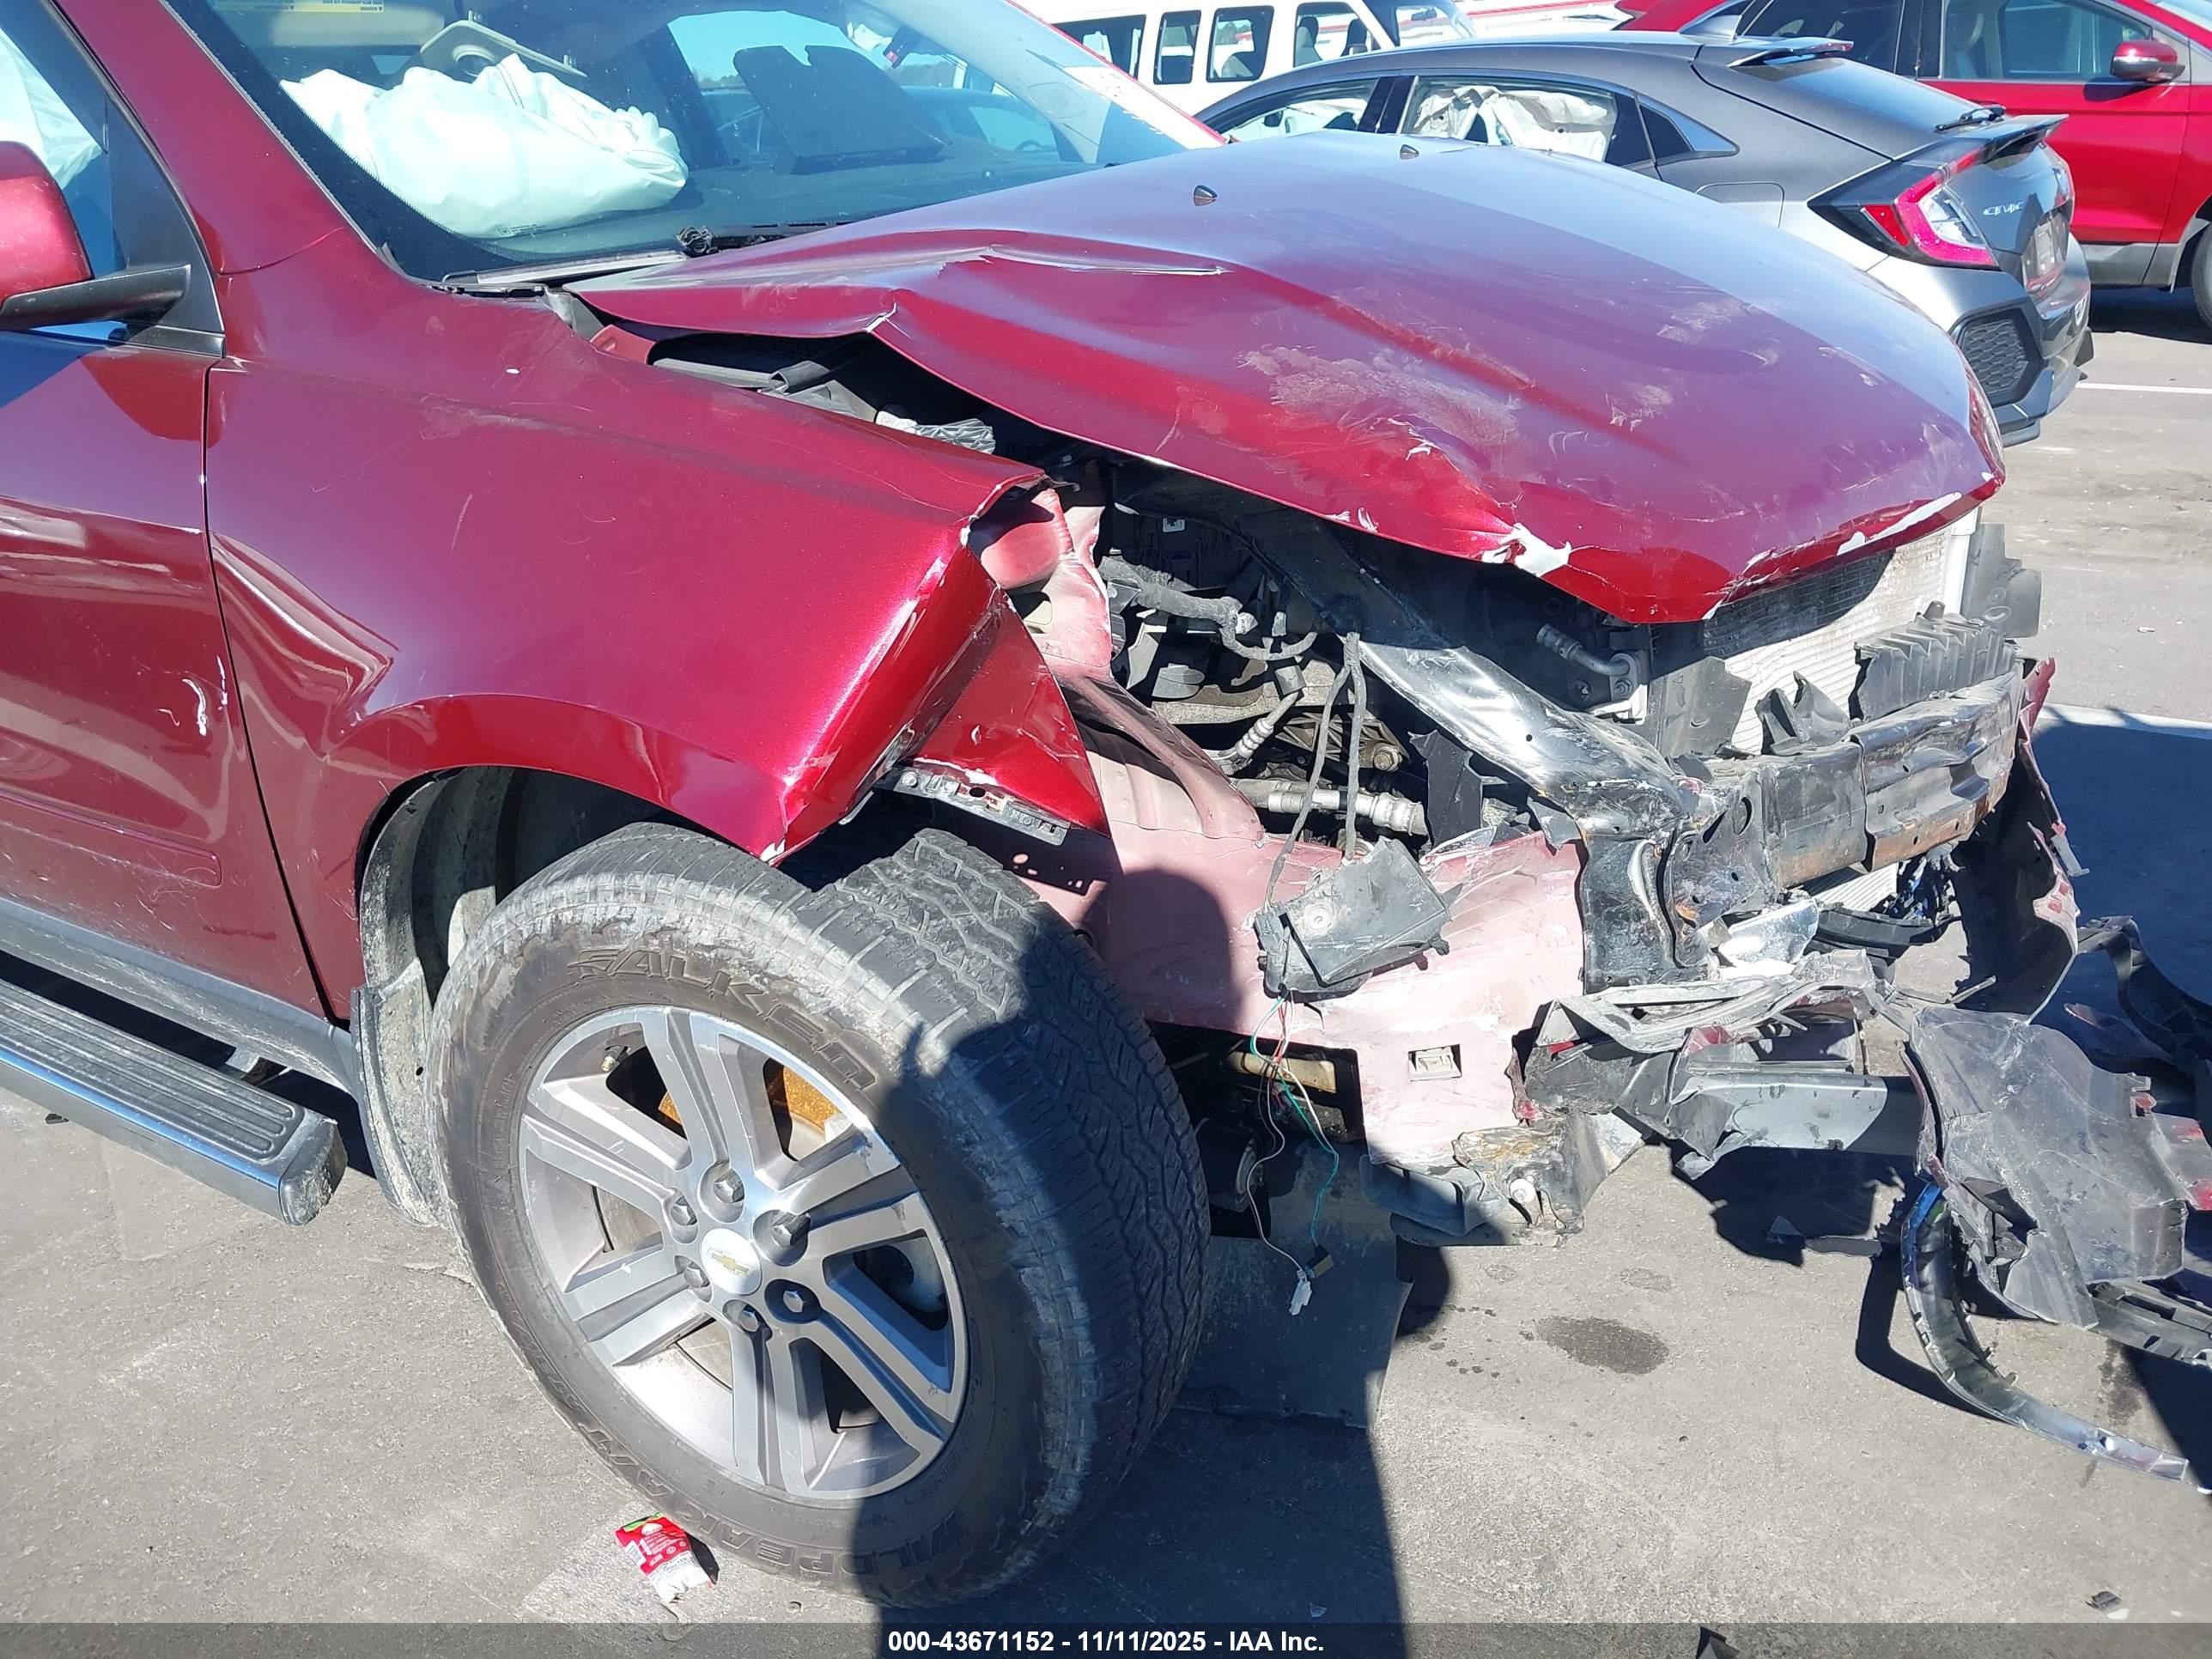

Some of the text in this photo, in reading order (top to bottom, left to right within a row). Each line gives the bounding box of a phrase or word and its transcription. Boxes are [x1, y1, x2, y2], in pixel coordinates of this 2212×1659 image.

[568, 948, 878, 1091] FALKEN
[577, 1422, 676, 1497] A/T
[681, 1503, 960, 1577] WILDPEAK
